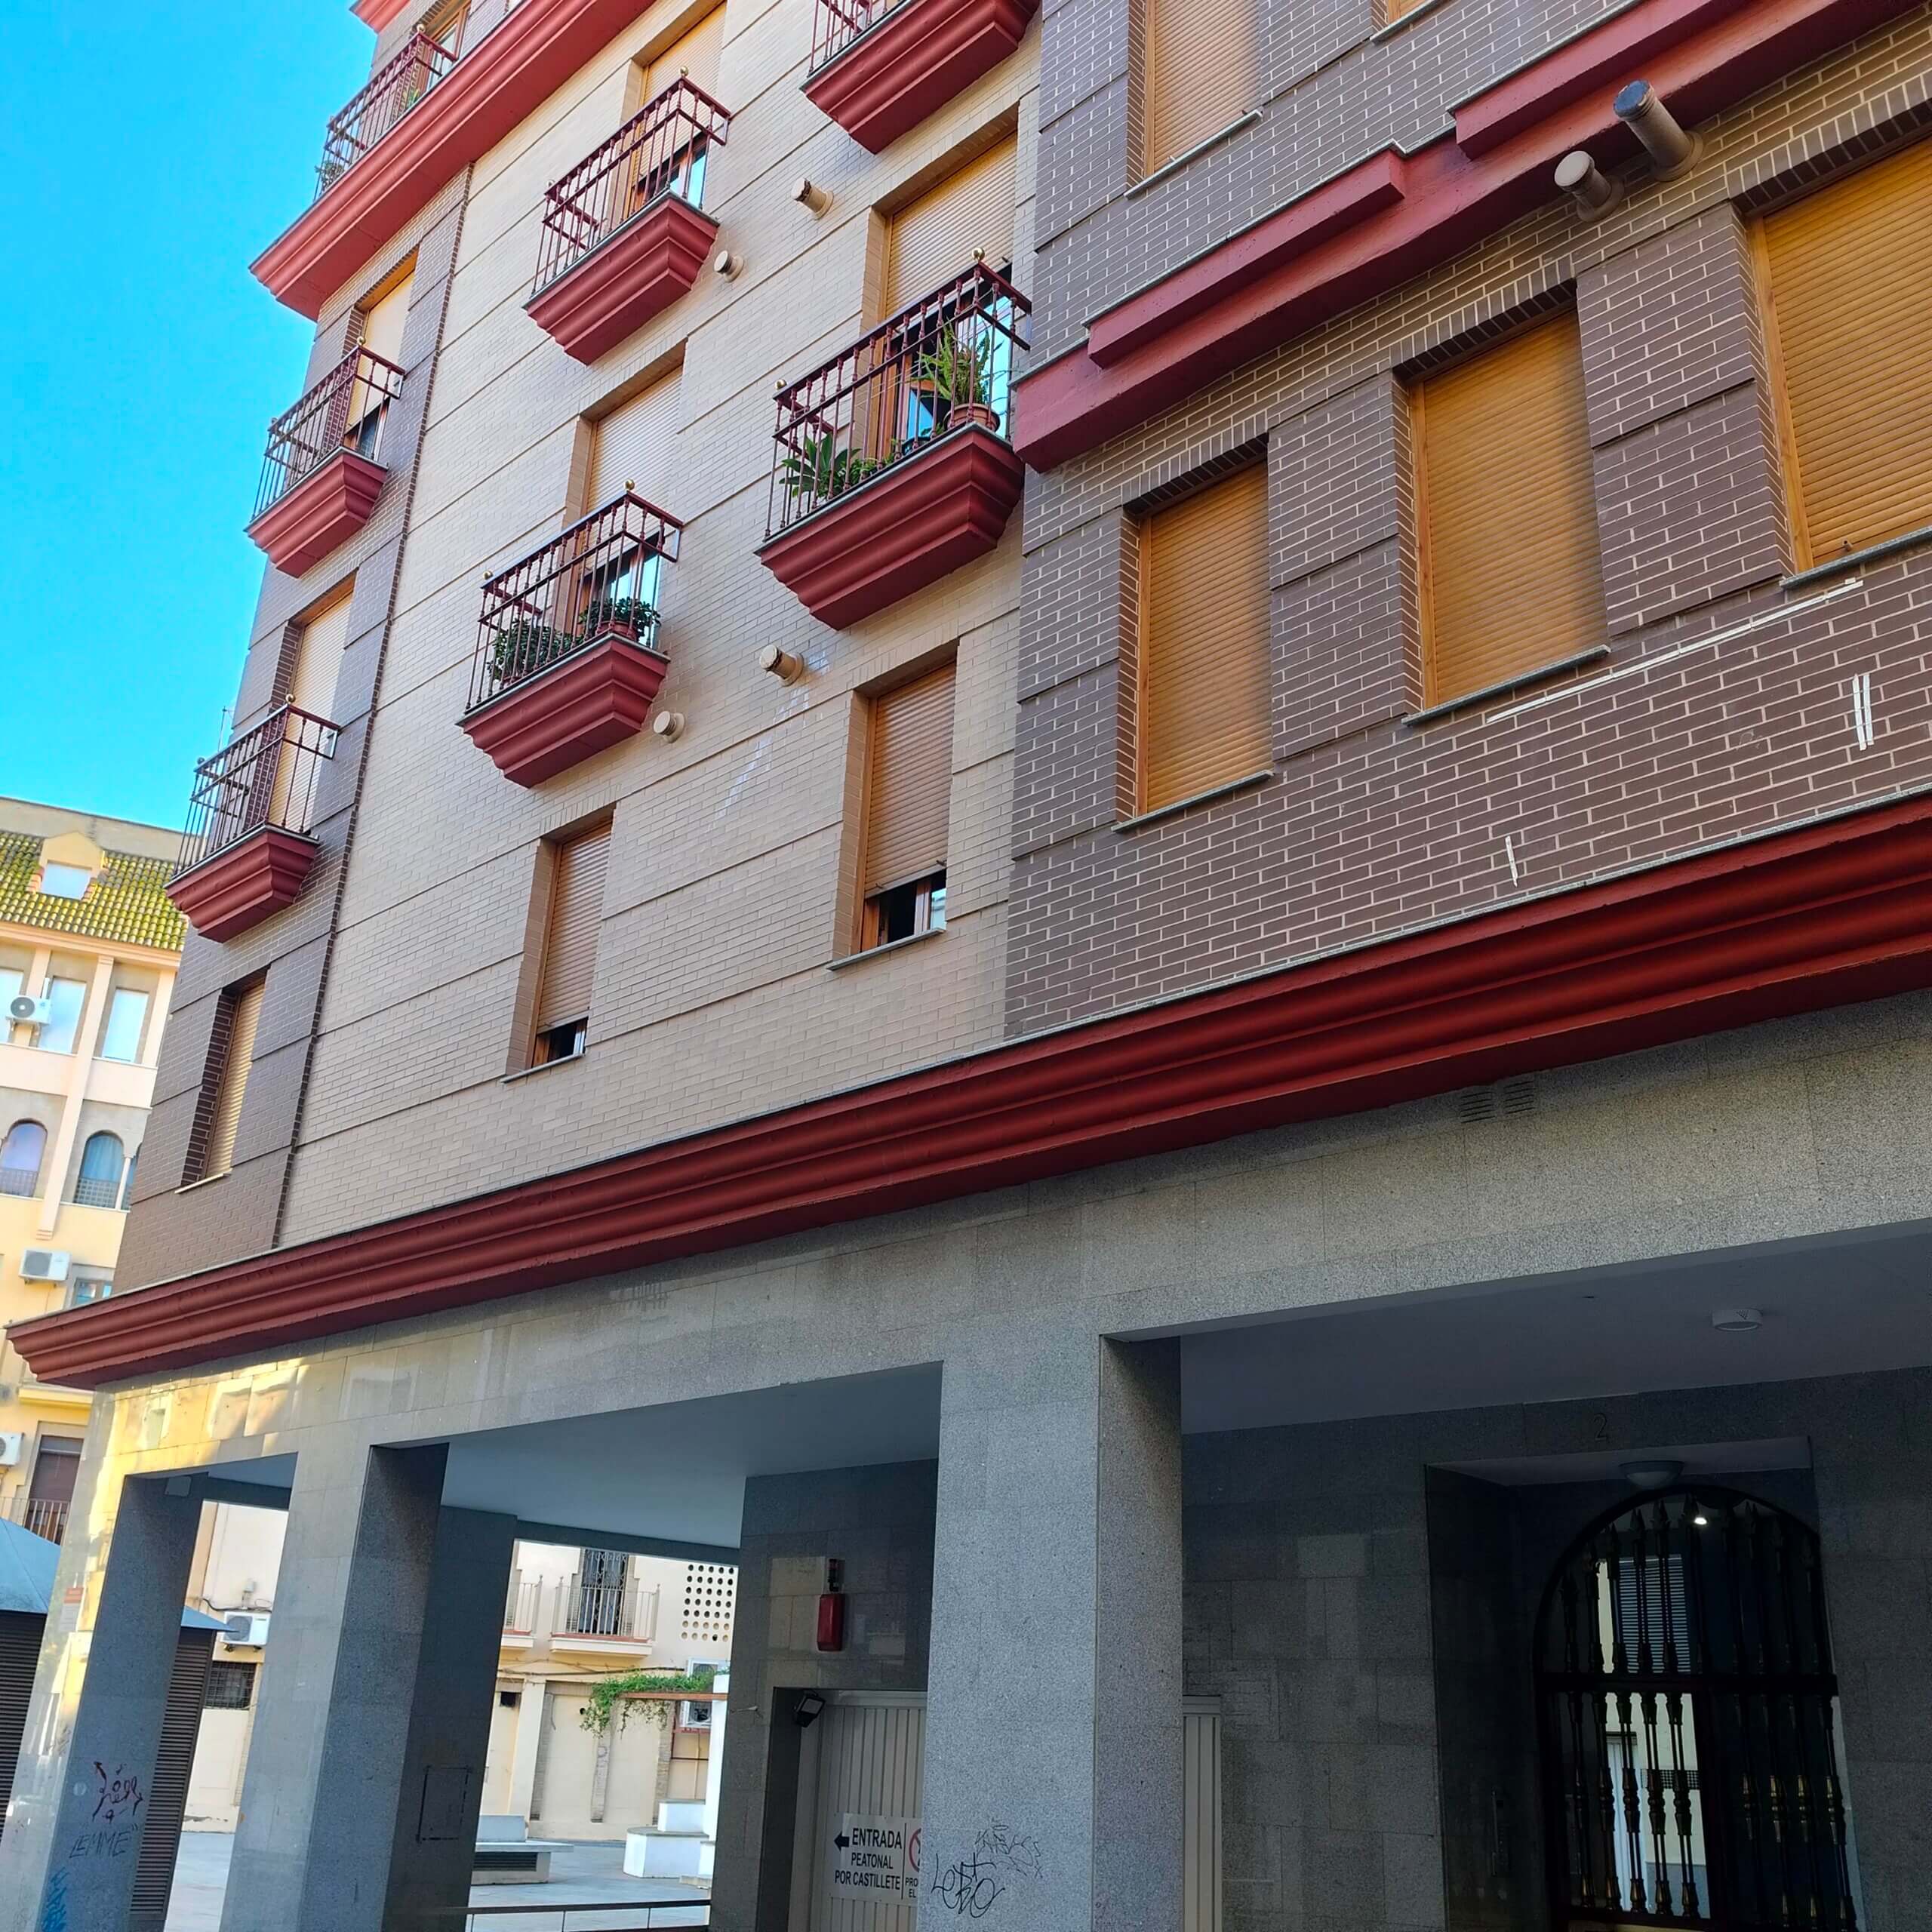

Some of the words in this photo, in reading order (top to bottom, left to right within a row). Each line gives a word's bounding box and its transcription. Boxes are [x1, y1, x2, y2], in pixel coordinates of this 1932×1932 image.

[1593, 1412, 1607, 1442] 2
[852, 1827, 903, 1849] ENTRADA
[851, 1852, 894, 1869] PEATONAL
[835, 1869, 851, 1884] POR
[853, 1872, 900, 1890] CASTILLETE
[909, 1888, 917, 1898] EL
